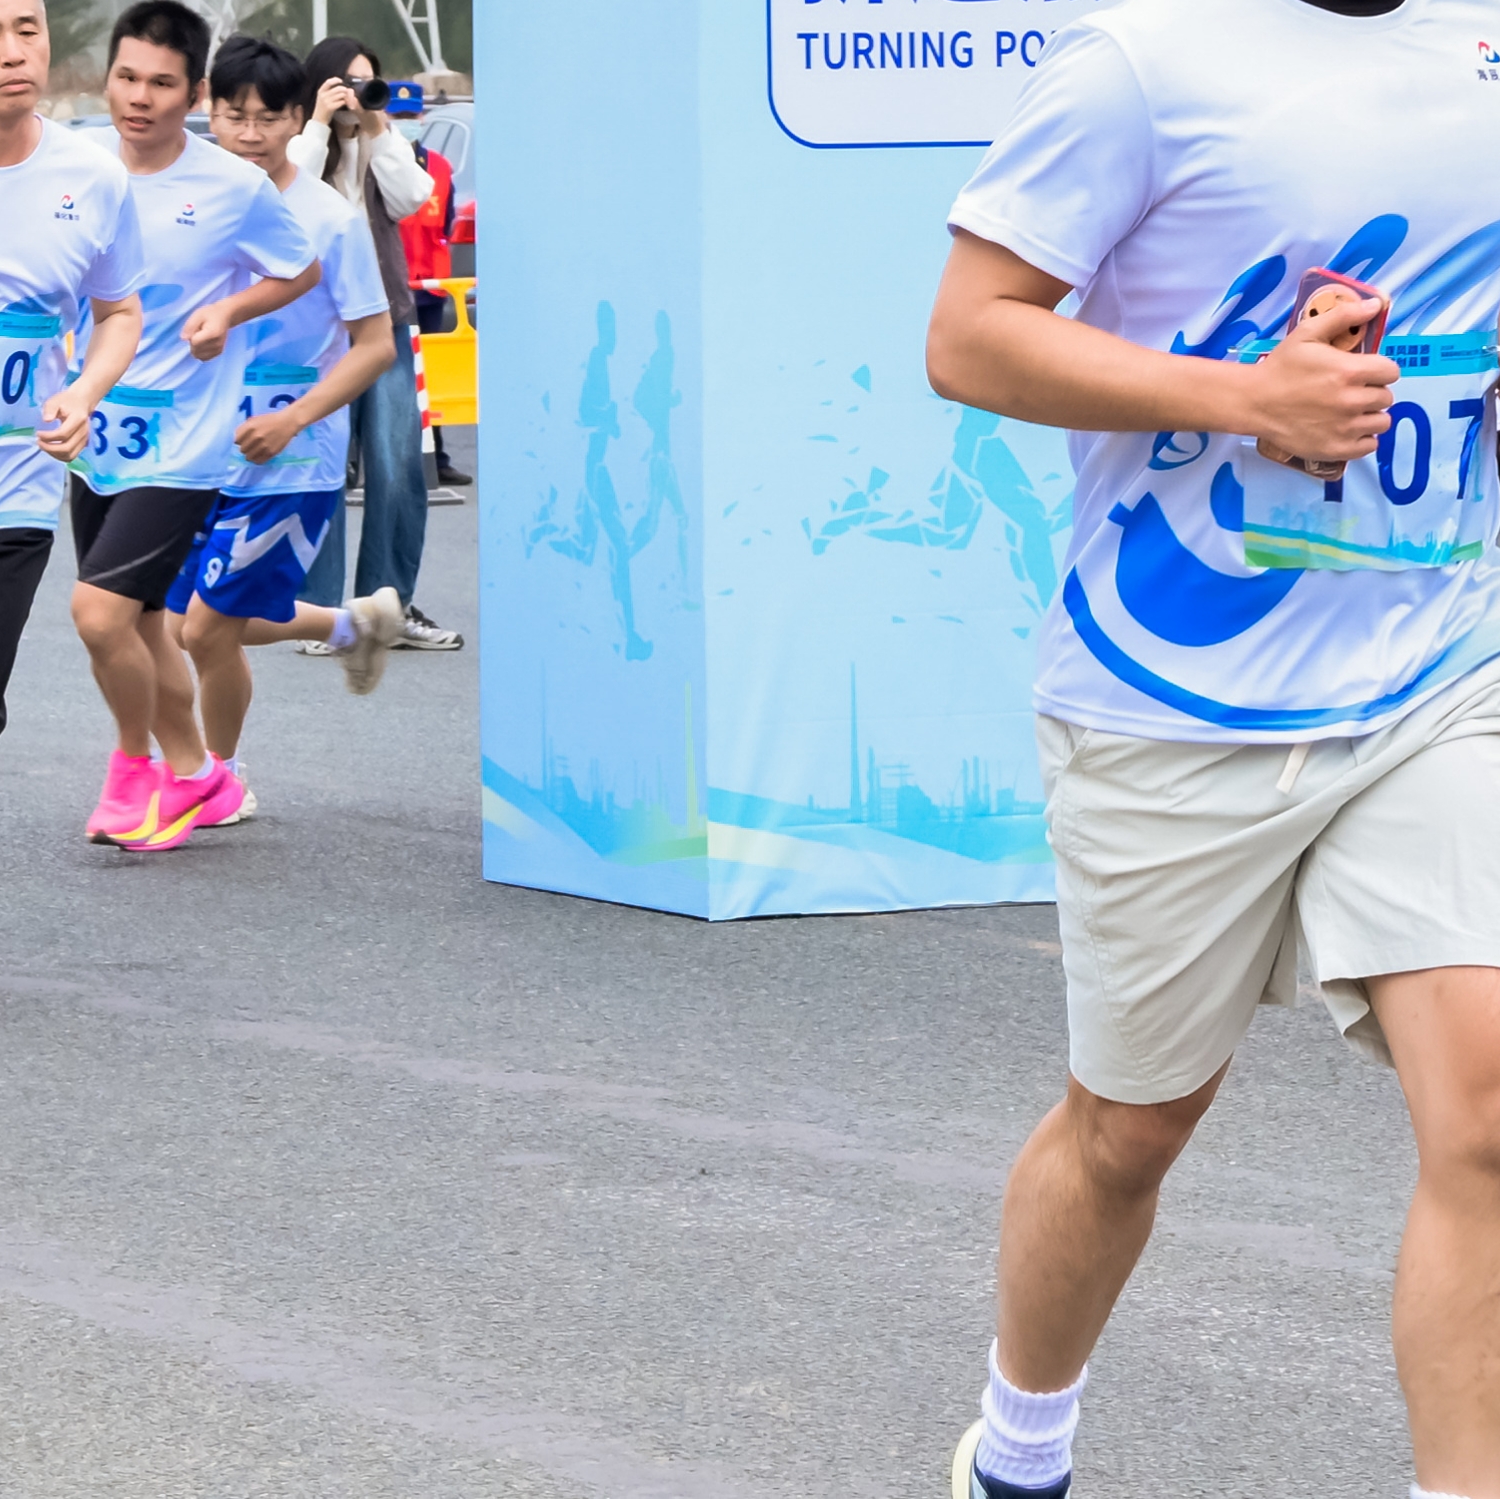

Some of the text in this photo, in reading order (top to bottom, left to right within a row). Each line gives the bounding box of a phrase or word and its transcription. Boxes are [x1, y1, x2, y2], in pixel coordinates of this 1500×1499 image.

[797, 30, 1063, 69] TURNING PO
[1324, 398, 1484, 506] 07
